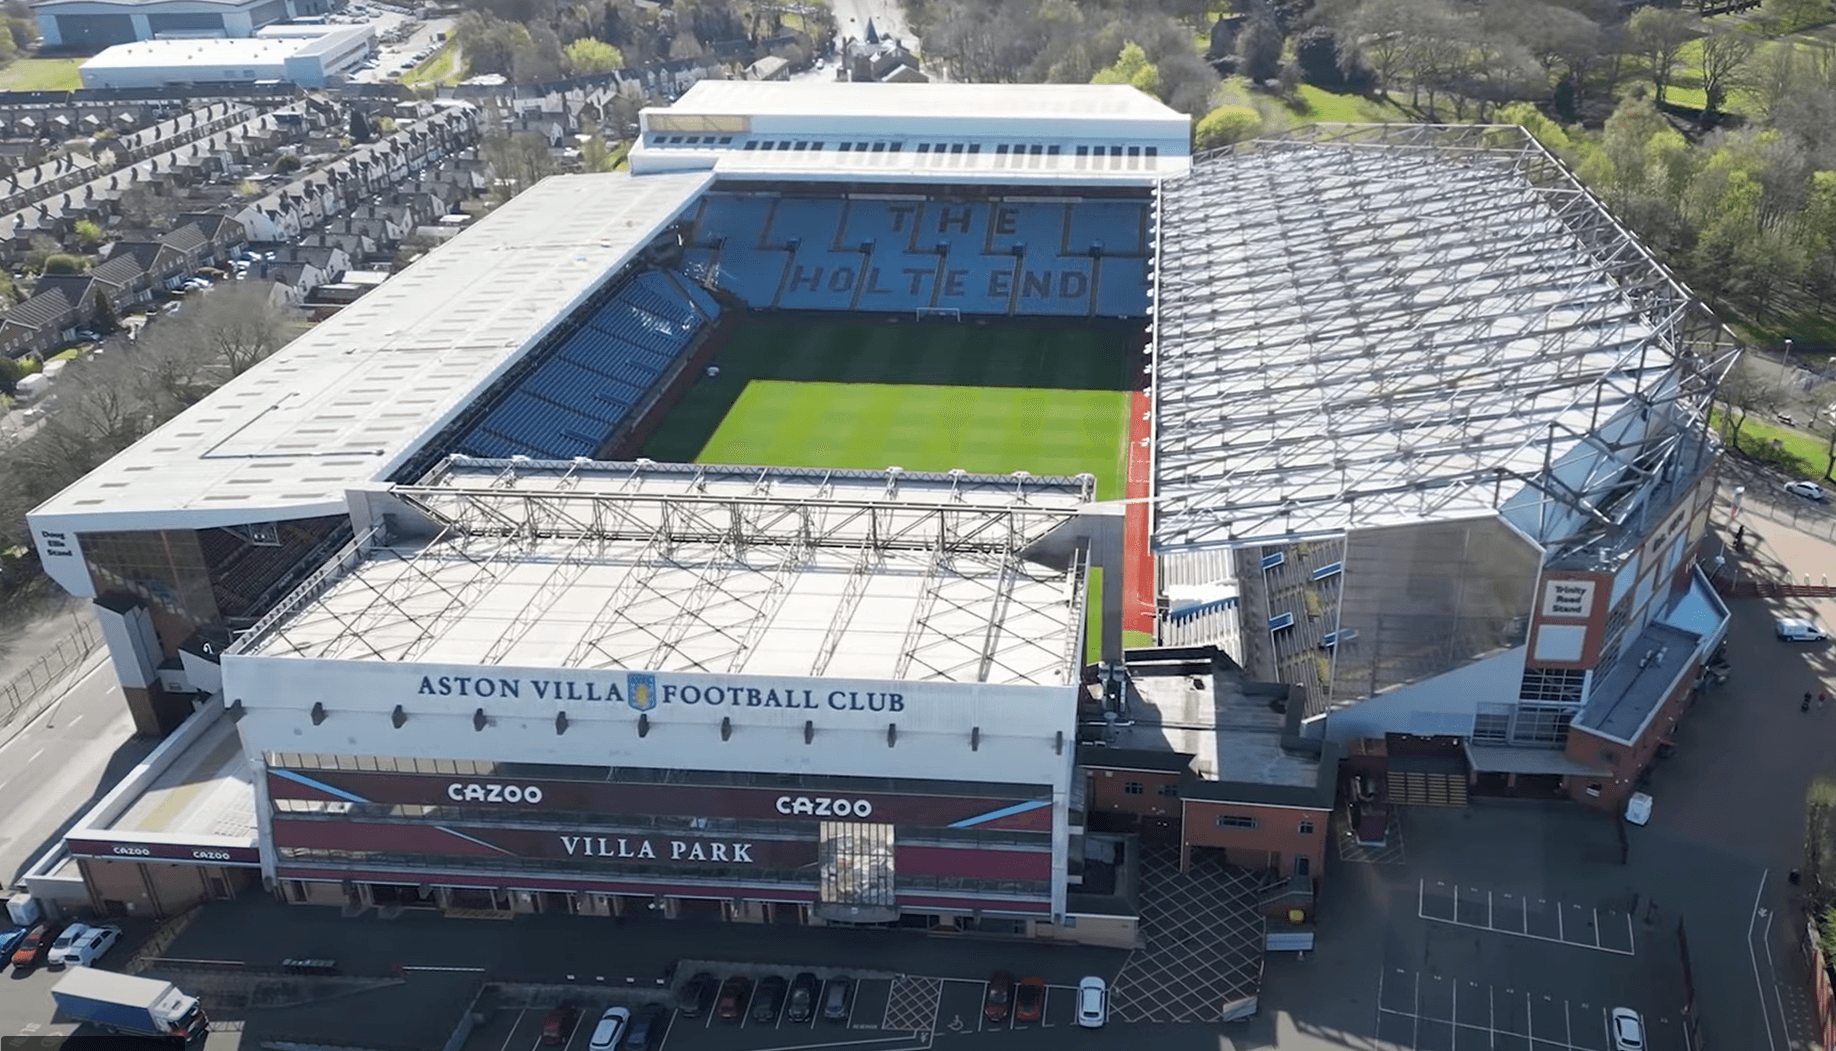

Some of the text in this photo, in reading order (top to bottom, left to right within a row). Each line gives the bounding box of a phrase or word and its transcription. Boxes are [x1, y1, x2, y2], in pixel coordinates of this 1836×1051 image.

[889, 206, 1019, 235] THE
[788, 265, 1087, 299] HOLTE END
[418, 675, 905, 712] ASTON VILLA FOOTBALL CLUB
[447, 783, 543, 804] CAZOO
[775, 796, 873, 818] CAZOO
[113, 846, 150, 856] CAZOO
[192, 850, 231, 860] CAZOO
[559, 836, 754, 863] VILLA PARK
